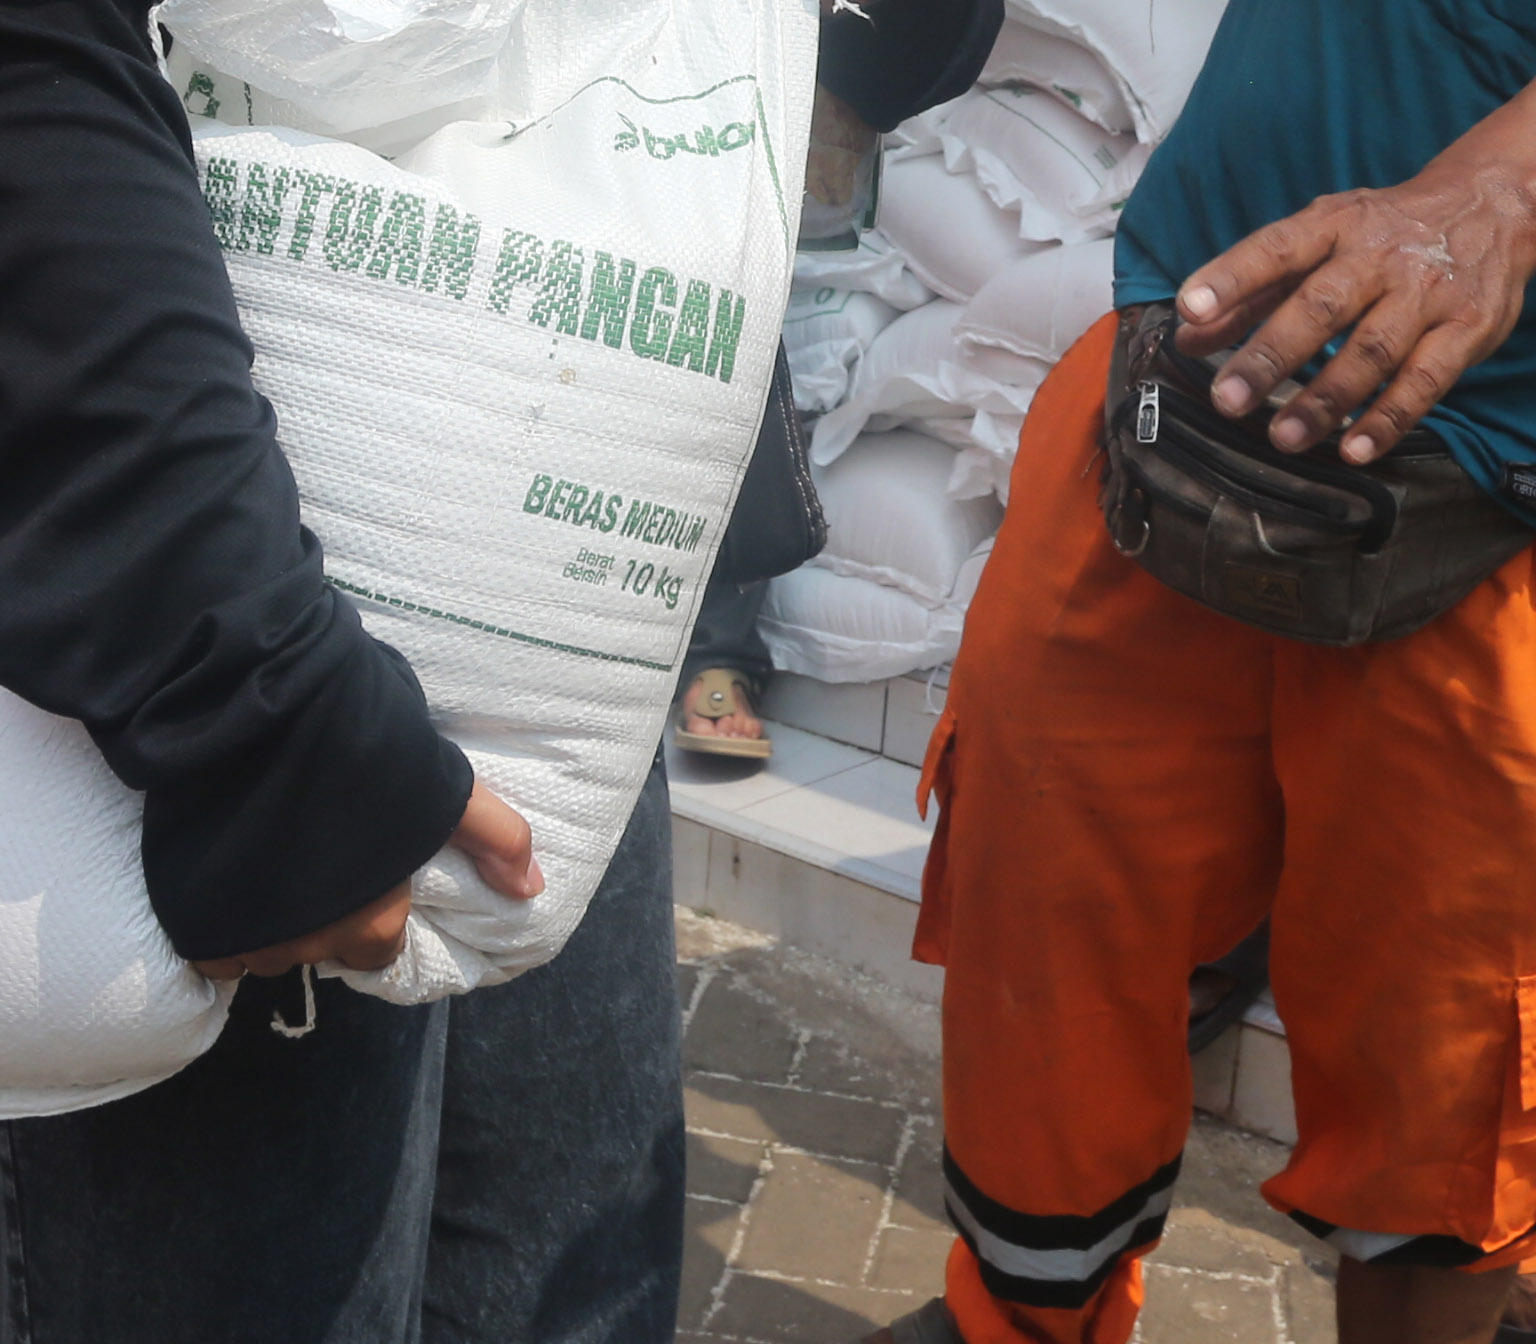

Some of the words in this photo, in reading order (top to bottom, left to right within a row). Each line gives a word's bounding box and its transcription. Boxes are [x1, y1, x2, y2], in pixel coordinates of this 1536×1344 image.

[205, 157, 481, 300] ANTUAN
[486, 227, 747, 385] PANGAN
[523, 473, 623, 533] BERAS
[621, 499, 707, 554] MEDIUM
[576, 546, 616, 570] Berat
[620, 558, 654, 596] 10
[654, 565, 684, 610] kg
